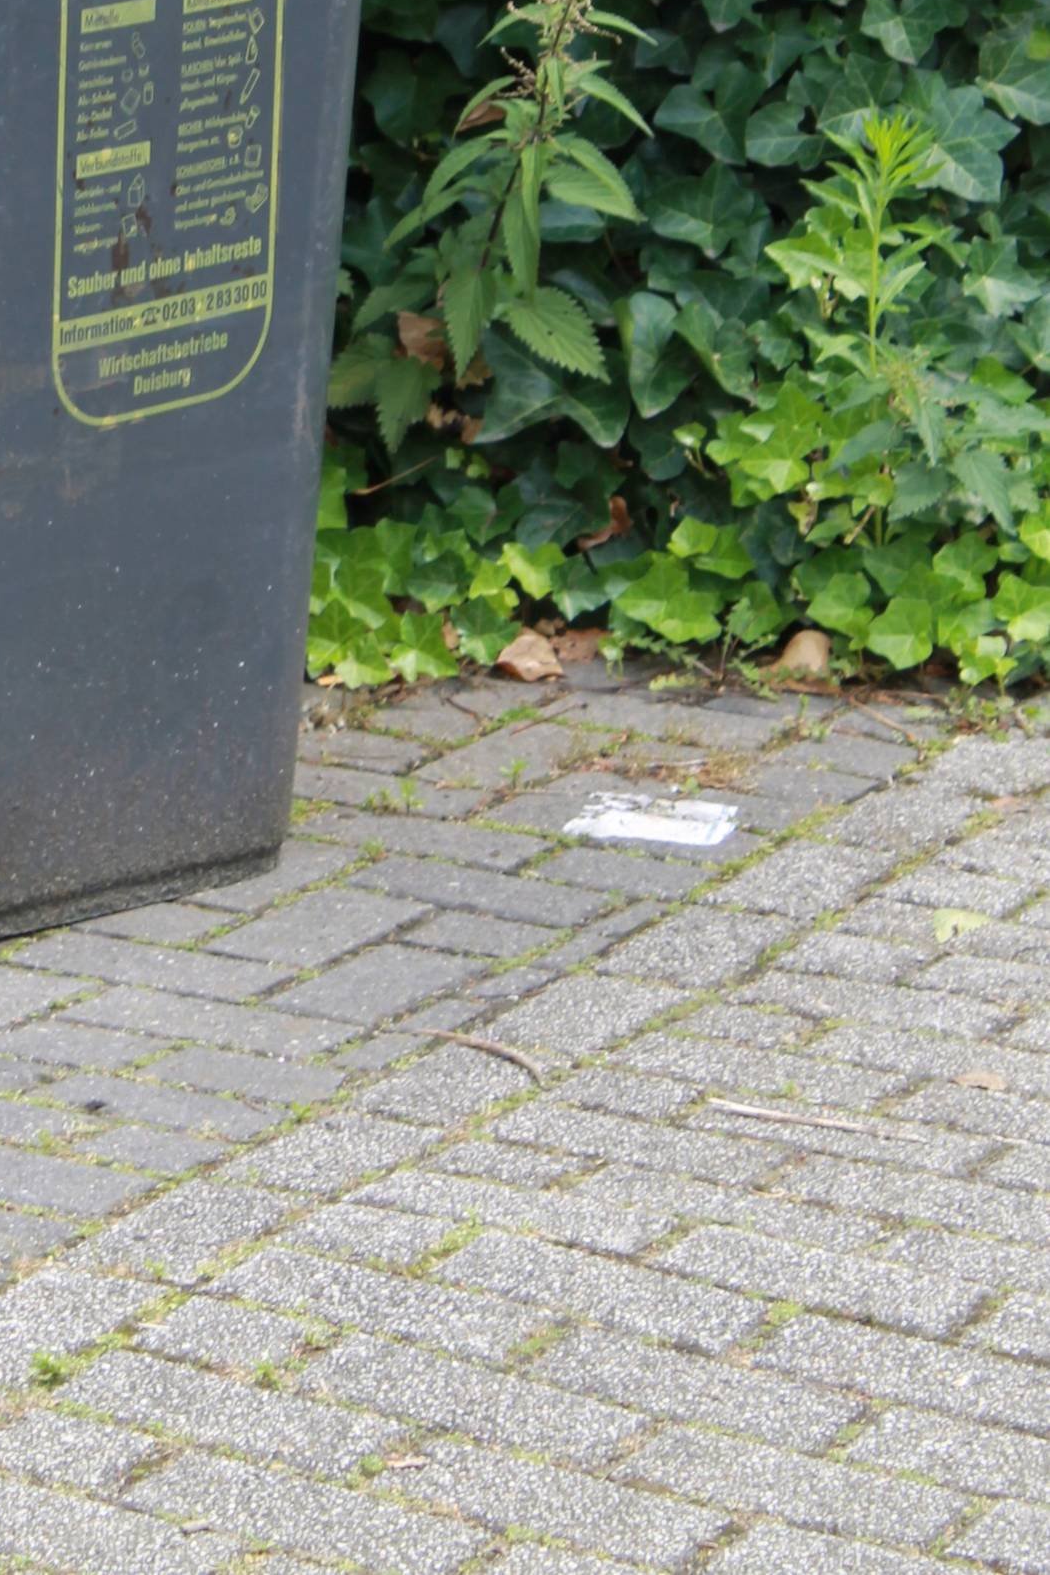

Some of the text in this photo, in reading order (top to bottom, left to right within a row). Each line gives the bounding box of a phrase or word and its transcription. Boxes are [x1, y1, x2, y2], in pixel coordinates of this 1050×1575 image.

[68, 236, 262, 298] Sauber und ohne Inhaltsreste
[162, 297, 196, 321] 0203
[99, 332, 228, 377] Wirtschaftsbetriebe
[133, 367, 192, 396] Duisburg
